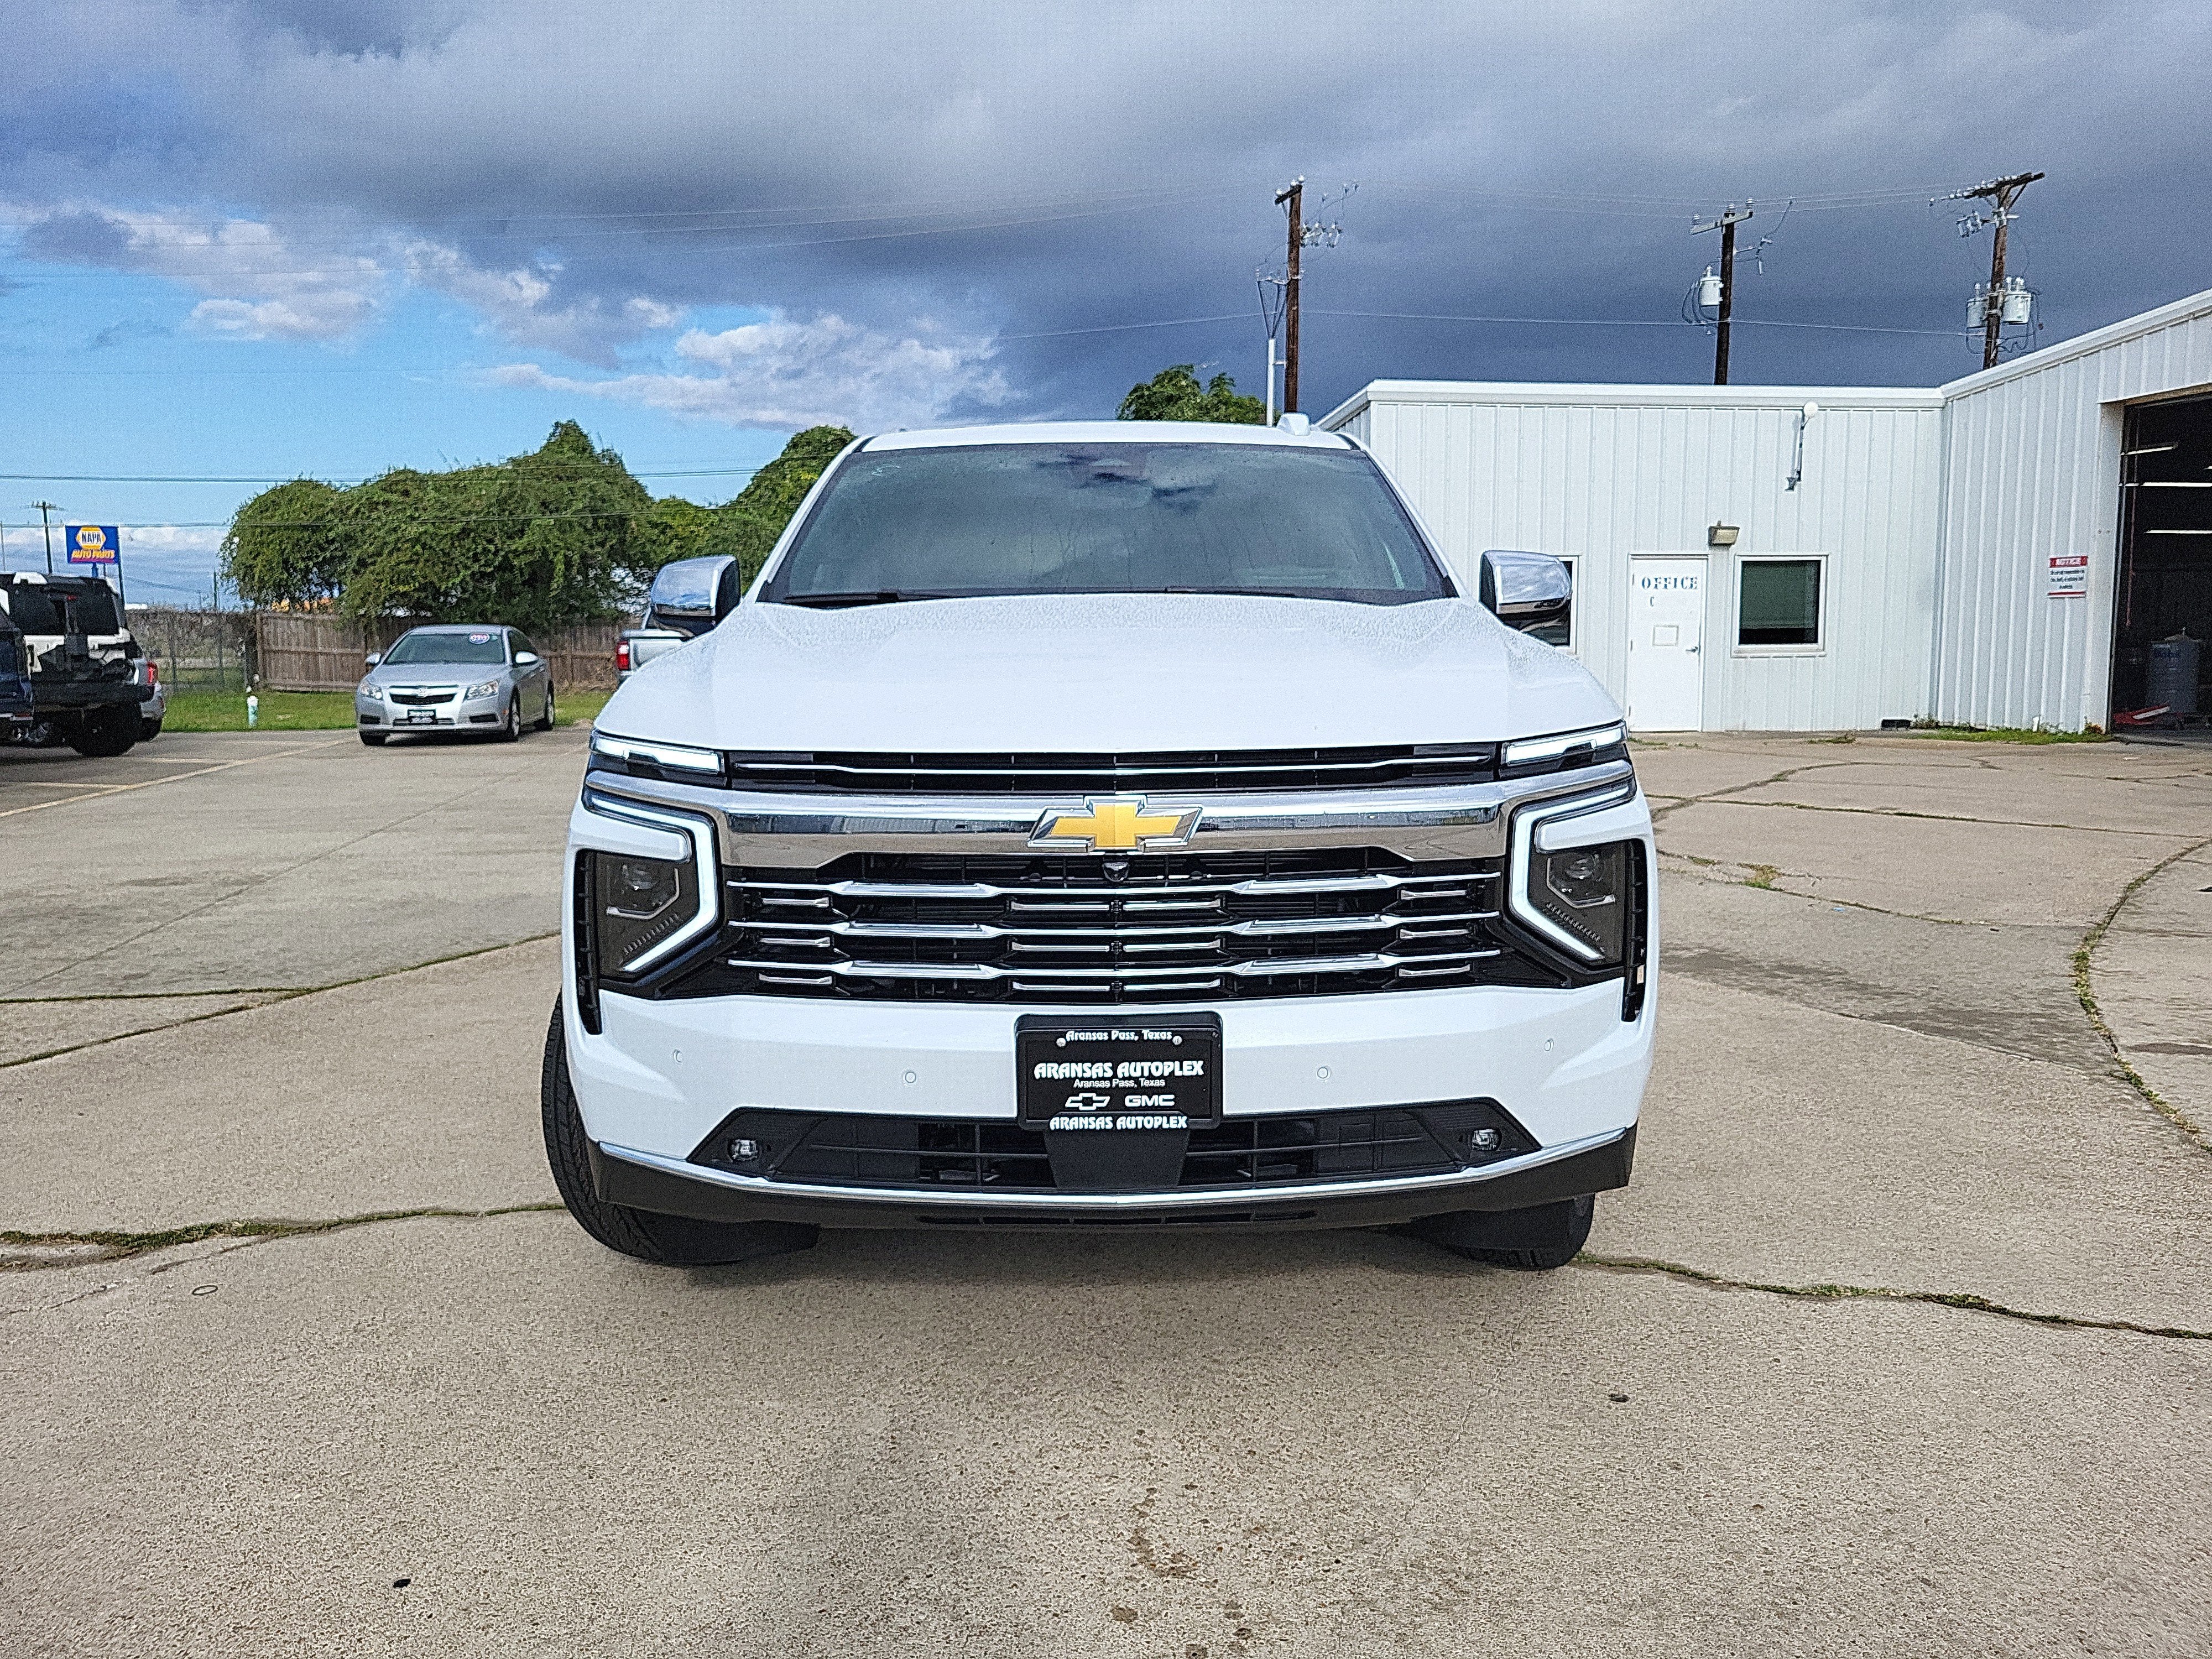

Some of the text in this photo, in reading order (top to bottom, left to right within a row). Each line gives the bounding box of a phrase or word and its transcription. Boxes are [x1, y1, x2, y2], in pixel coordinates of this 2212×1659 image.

[81, 532, 102, 542] NAPA
[71, 549, 92, 559] AUTO
[1641, 577, 1698, 589] OFFICE
[1066, 1030, 1172, 1041] Aransas Pass, Texas
[1034, 1060, 1204, 1079] ARANSAS AUTOPLEX
[1073, 1078, 1165, 1088] Aransas Pass, Texas
[1124, 1094, 1175, 1107] GMC
[1050, 1116, 1188, 1130] ARANSAS AUTOPLEX
